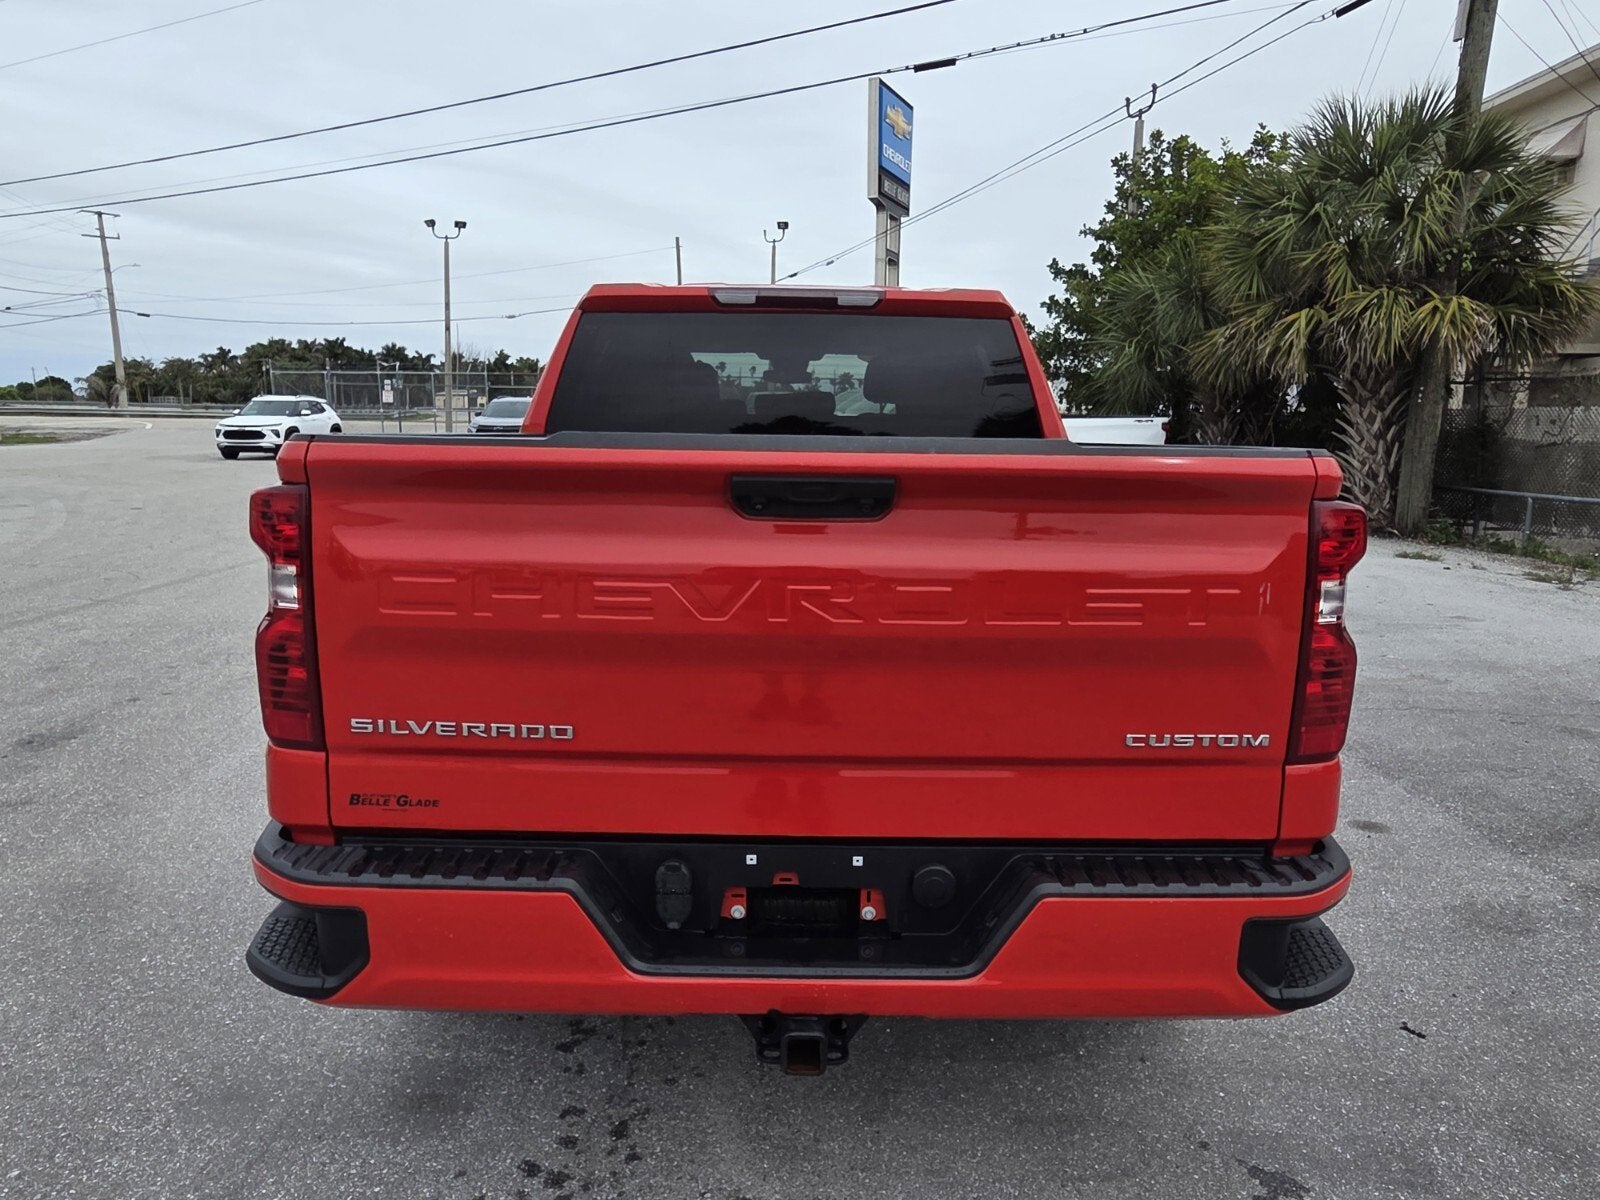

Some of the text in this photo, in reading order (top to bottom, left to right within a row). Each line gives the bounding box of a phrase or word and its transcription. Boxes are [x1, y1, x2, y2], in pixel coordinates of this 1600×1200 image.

[377, 571, 1245, 626] CHEVROLET
[350, 718, 574, 740] SILVERADO
[1125, 733, 1270, 748] CUSTOM
[348, 793, 440, 808] BELLE GLADE
